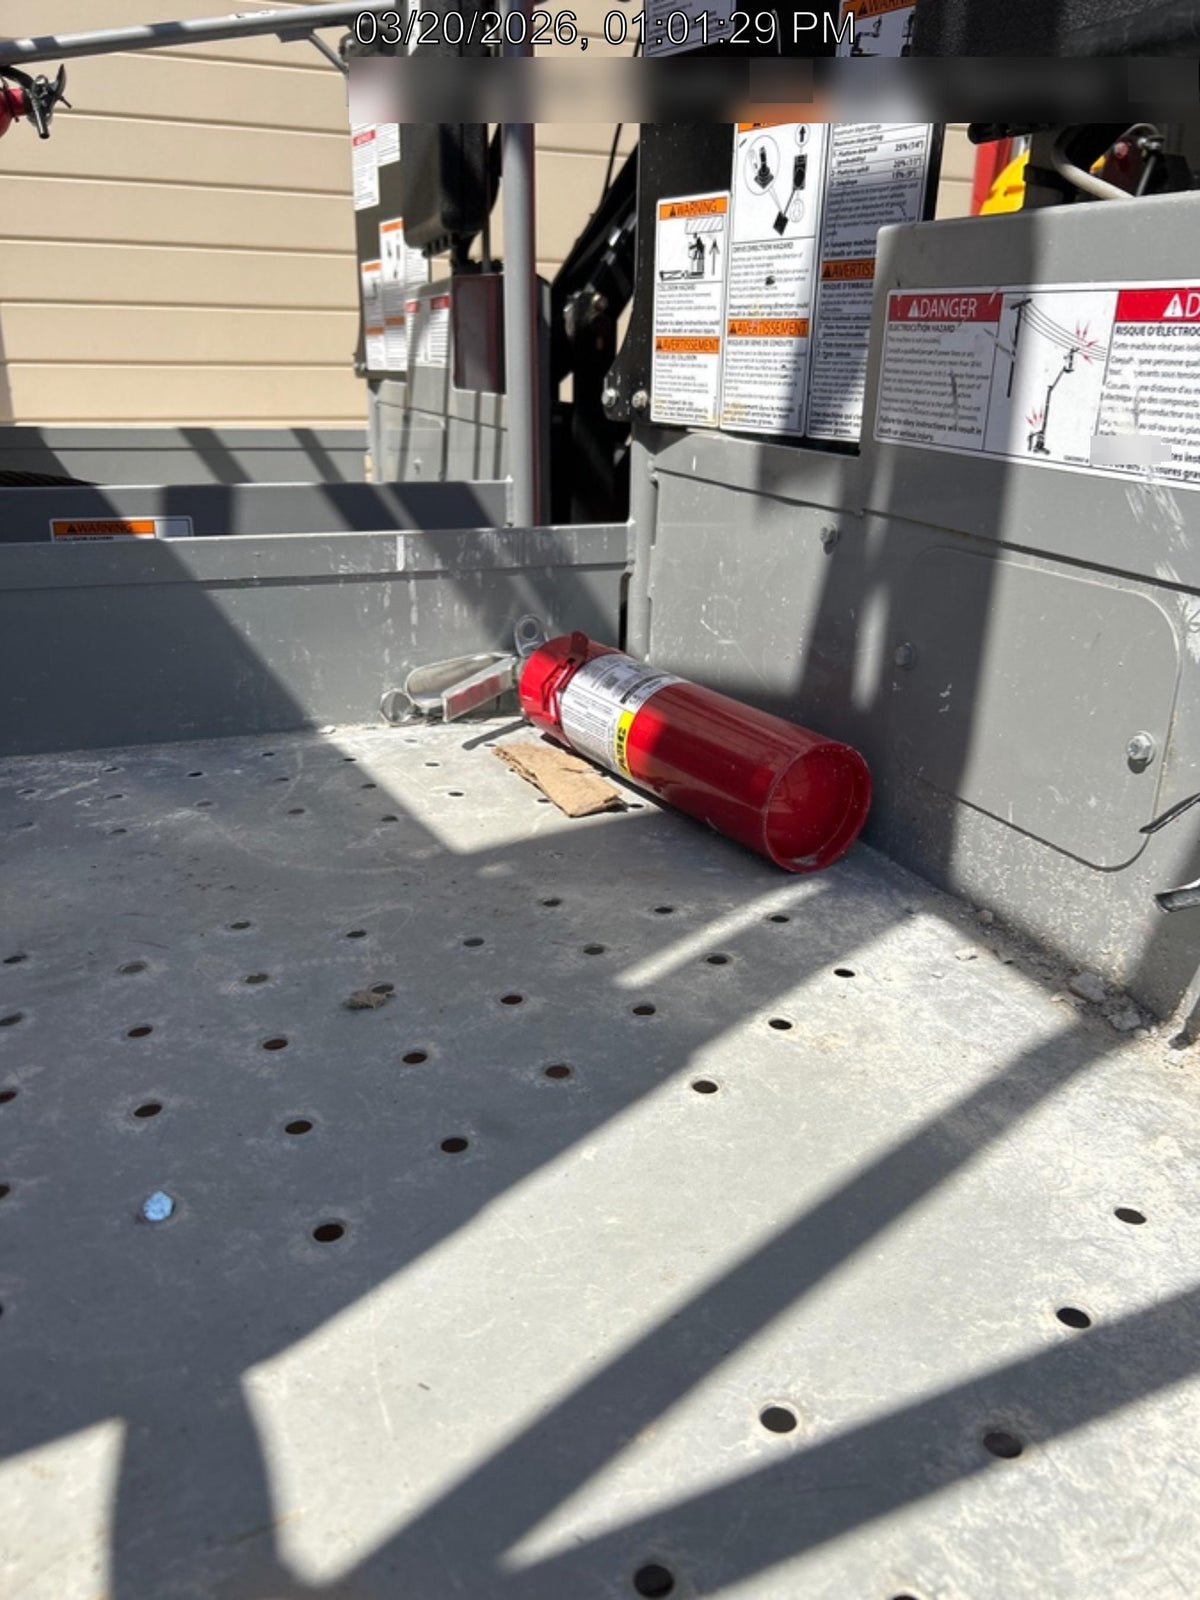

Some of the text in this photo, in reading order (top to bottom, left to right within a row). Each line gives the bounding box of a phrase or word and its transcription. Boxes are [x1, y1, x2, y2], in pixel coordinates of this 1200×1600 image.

[677, 199, 717, 215] WARNING
[919, 297, 977, 318] DANGER
[737, 319, 808, 336] AVERTISSEMENT
[1116, 326, 1145, 337] RISQUE
[662, 337, 718, 352] AVERTISSEMENT
